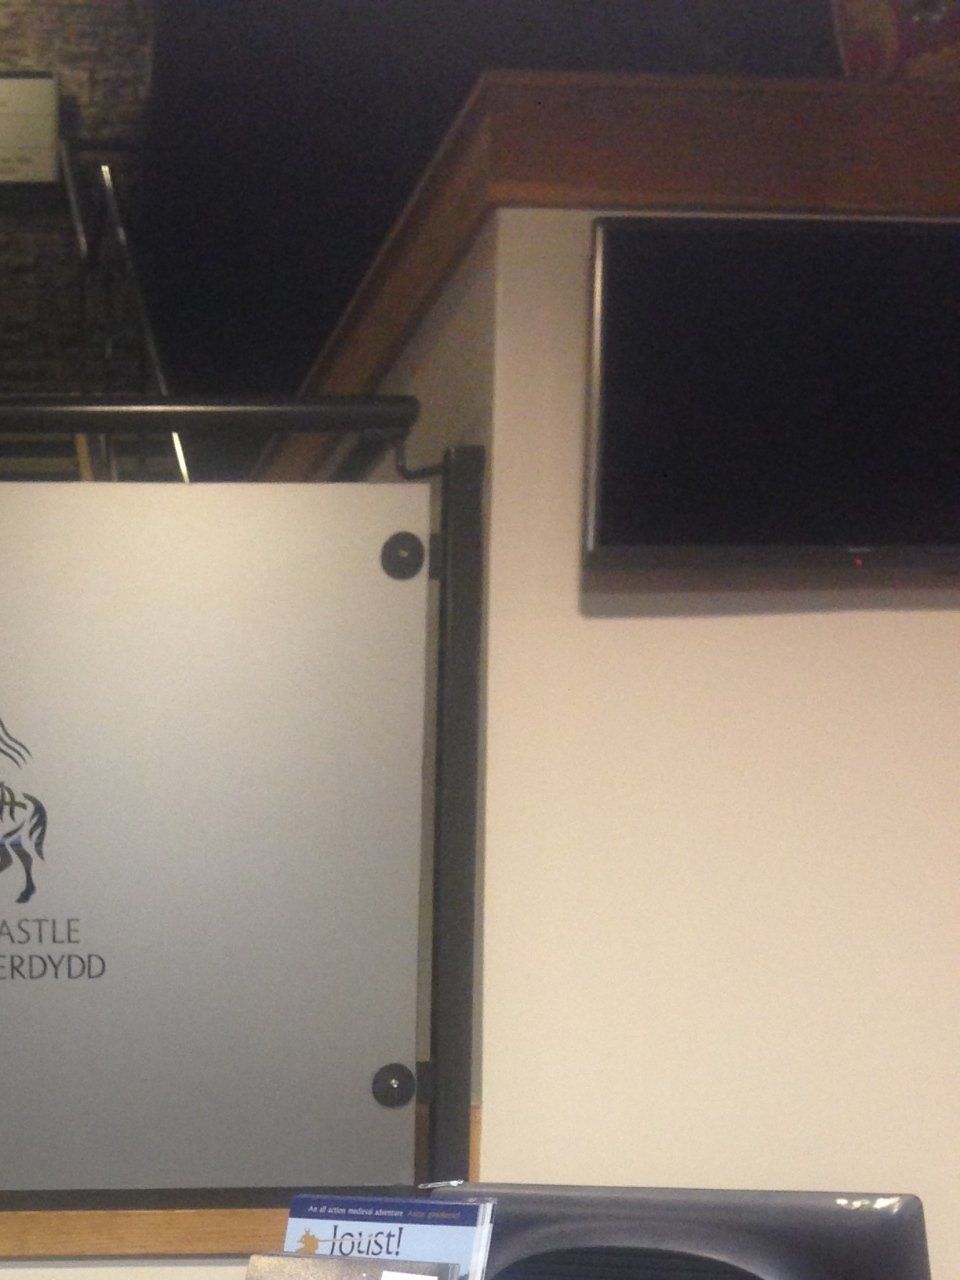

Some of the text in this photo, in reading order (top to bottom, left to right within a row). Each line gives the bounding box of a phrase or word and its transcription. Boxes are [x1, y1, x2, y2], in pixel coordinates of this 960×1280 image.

[328, 1207, 346, 1215] action
[348, 1207, 373, 1216] medieval
[374, 1208, 404, 1217] adventure
[330, 1224, 404, 1257] Joust!
